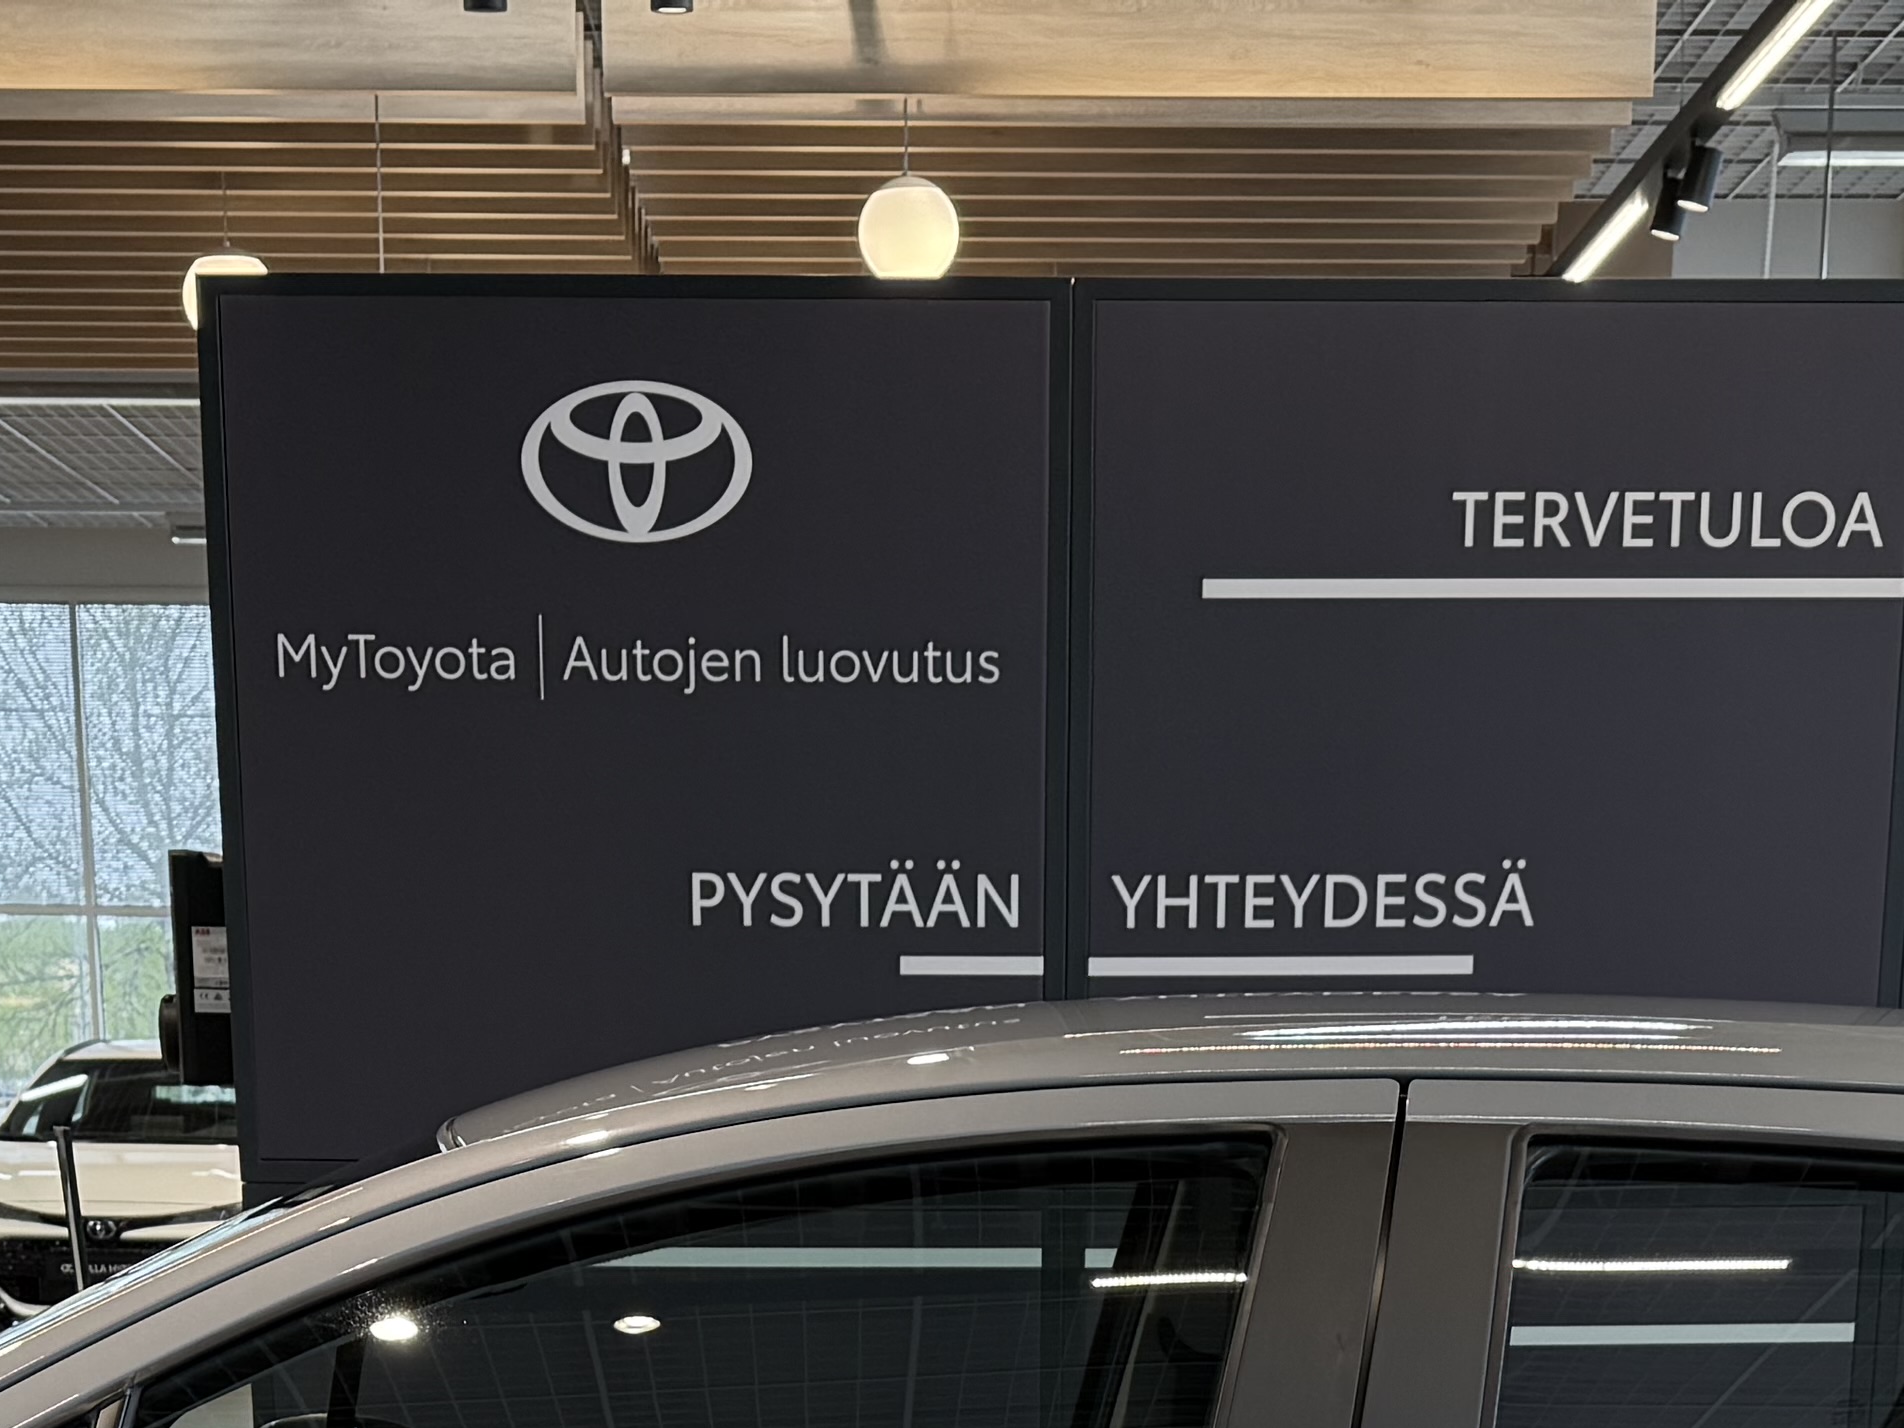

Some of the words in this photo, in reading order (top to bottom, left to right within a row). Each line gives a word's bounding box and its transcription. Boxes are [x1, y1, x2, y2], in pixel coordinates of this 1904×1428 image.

[1451, 490, 1884, 548] TERVETULOA
[276, 633, 517, 692] MyToyota
[563, 636, 762, 695] Autojen
[781, 634, 1001, 684] luovutus
[691, 859, 1020, 928] PYSYTÄÄN
[1111, 858, 1534, 929] YHTEYDESSÄ
